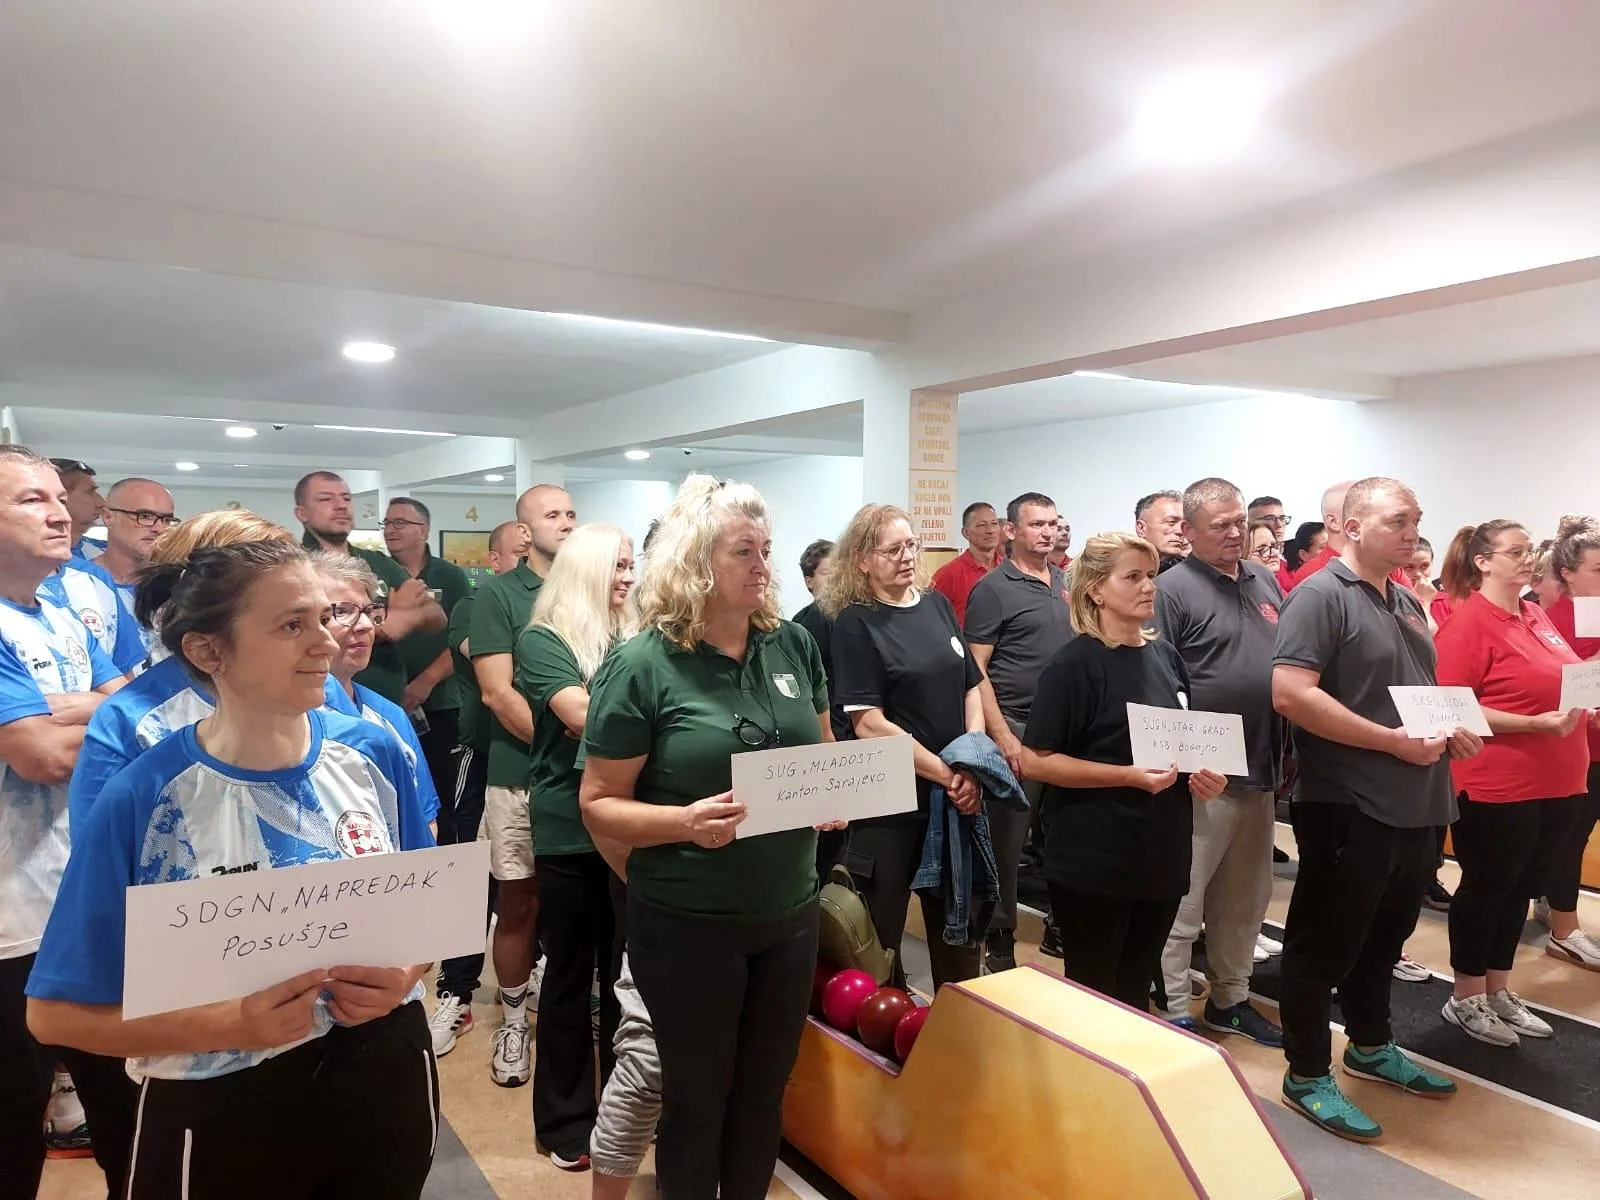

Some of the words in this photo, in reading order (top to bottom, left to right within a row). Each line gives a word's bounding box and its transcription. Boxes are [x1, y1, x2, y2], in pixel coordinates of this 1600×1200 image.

[465, 505, 479, 522] 4
[920, 519, 945, 529] ZELENO
[824, 772, 886, 793] Sarajevo
